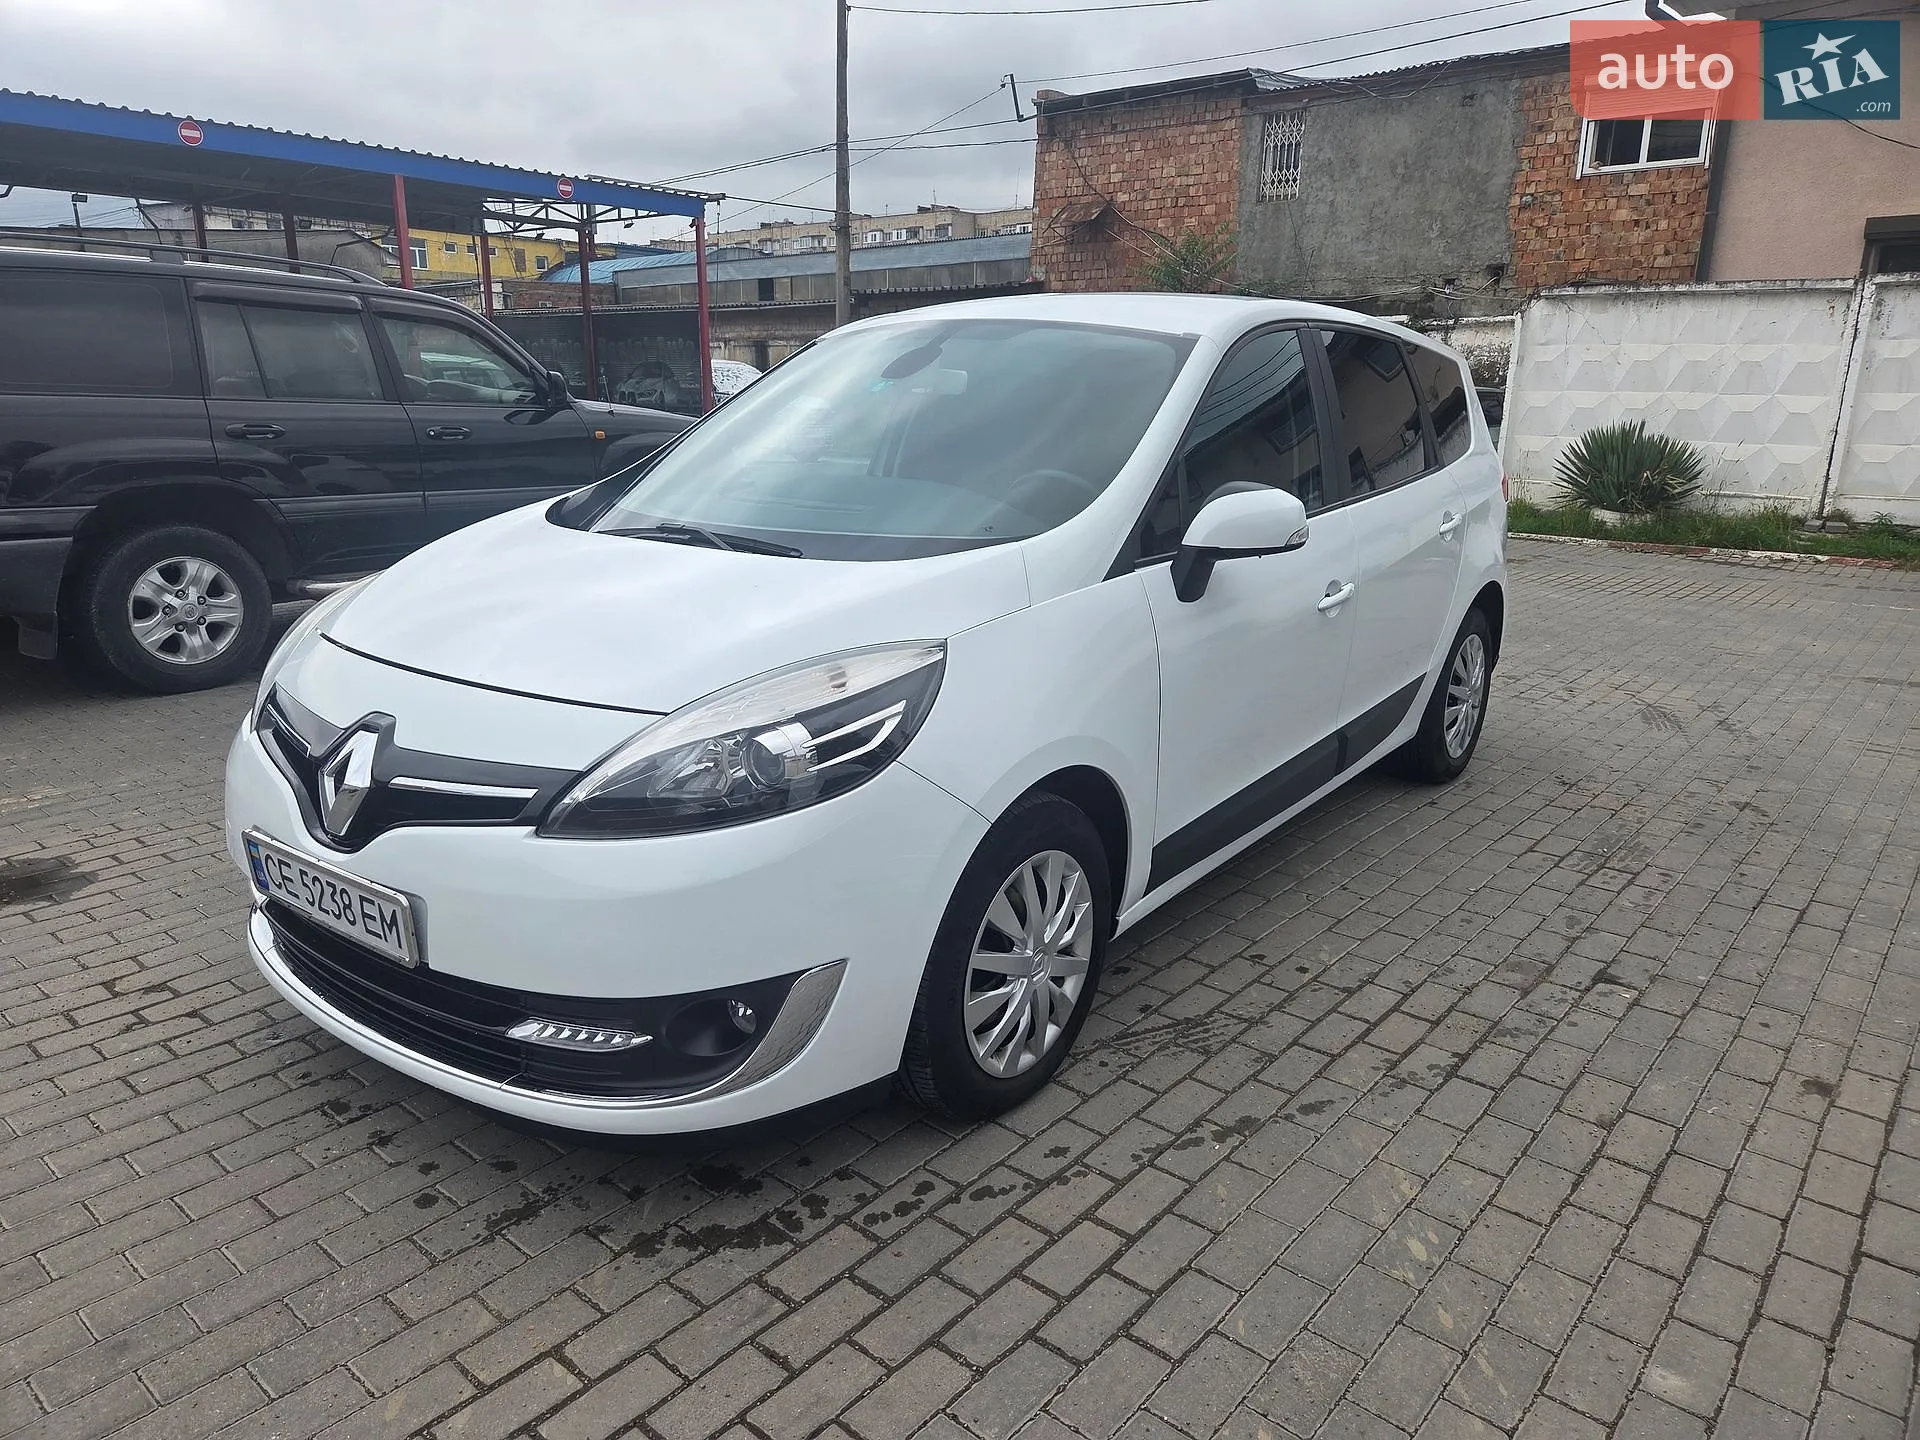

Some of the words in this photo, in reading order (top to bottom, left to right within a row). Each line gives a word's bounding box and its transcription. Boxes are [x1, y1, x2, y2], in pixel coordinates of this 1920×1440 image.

[264, 853, 300, 900] CE
[299, 868, 357, 927] 5238
[358, 894, 403, 949] EM
